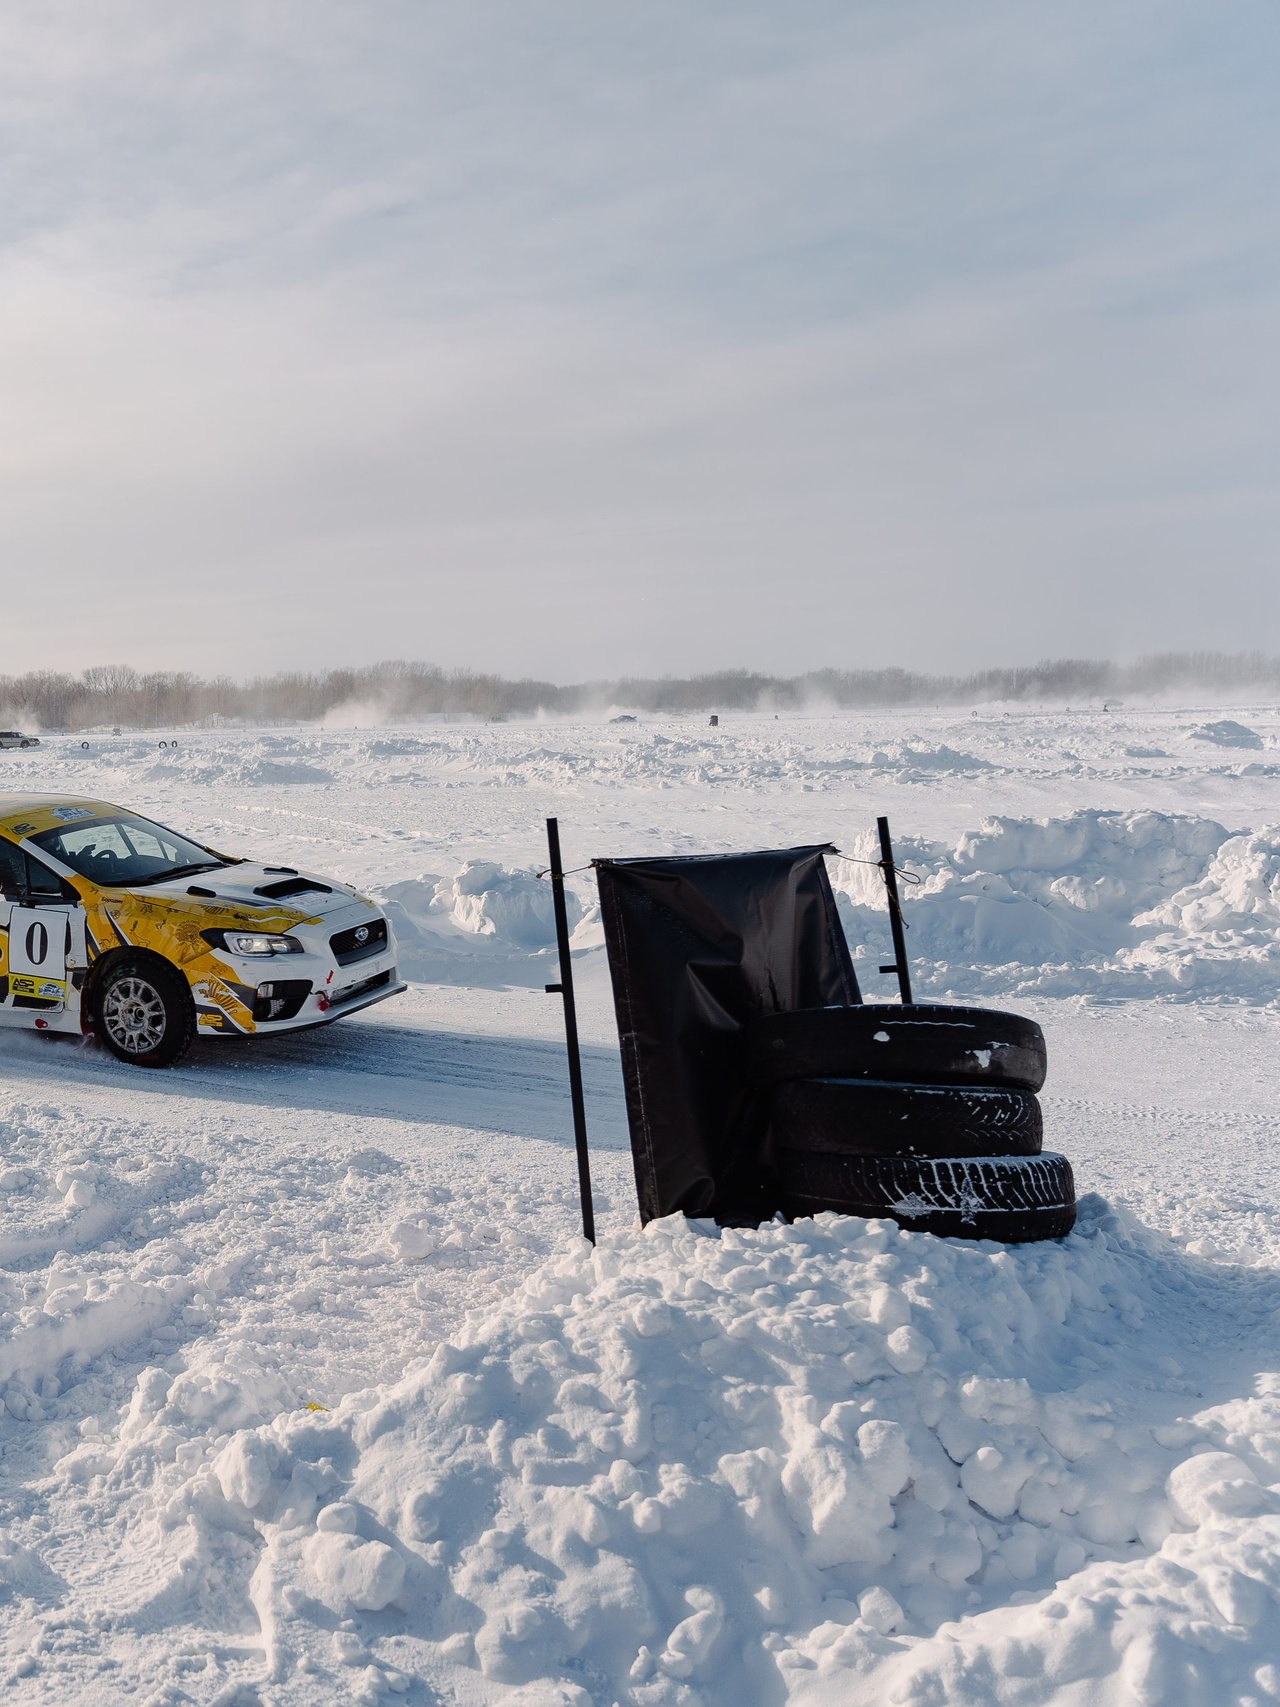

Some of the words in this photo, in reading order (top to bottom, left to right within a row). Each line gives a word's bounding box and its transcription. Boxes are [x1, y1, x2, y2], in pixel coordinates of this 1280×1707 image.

[25, 921, 48, 965] 0
[13, 977, 35, 988] ASP
[200, 1013, 223, 1022] ASP
